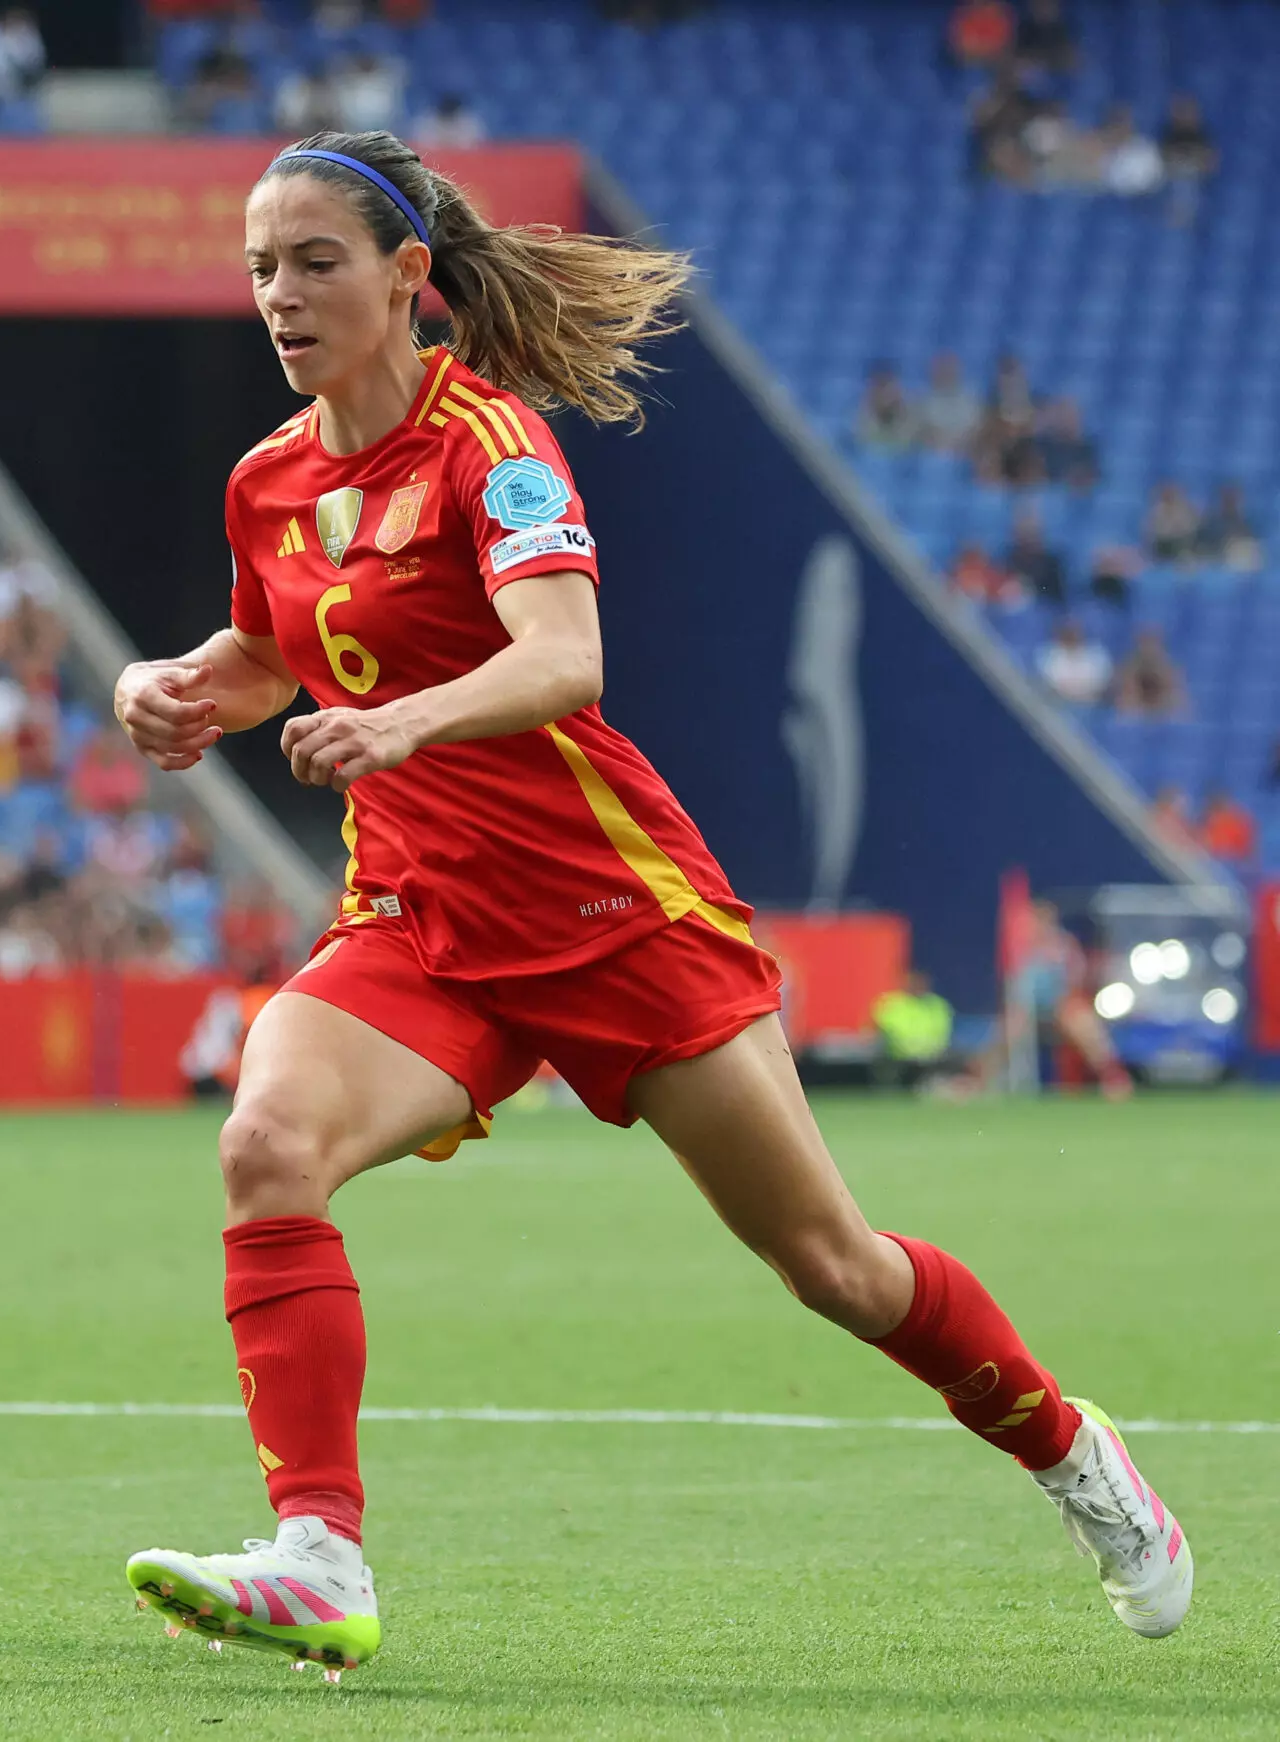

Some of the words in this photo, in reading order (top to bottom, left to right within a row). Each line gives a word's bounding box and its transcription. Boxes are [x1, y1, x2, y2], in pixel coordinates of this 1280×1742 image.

[511, 489, 532, 498] Play
[513, 496, 546, 507] Strong
[327, 536, 340, 548] FIFA
[493, 534, 561, 561] FOUNDATION
[315, 583, 380, 695] 6
[579, 895, 633, 917] HEAT.RDY
